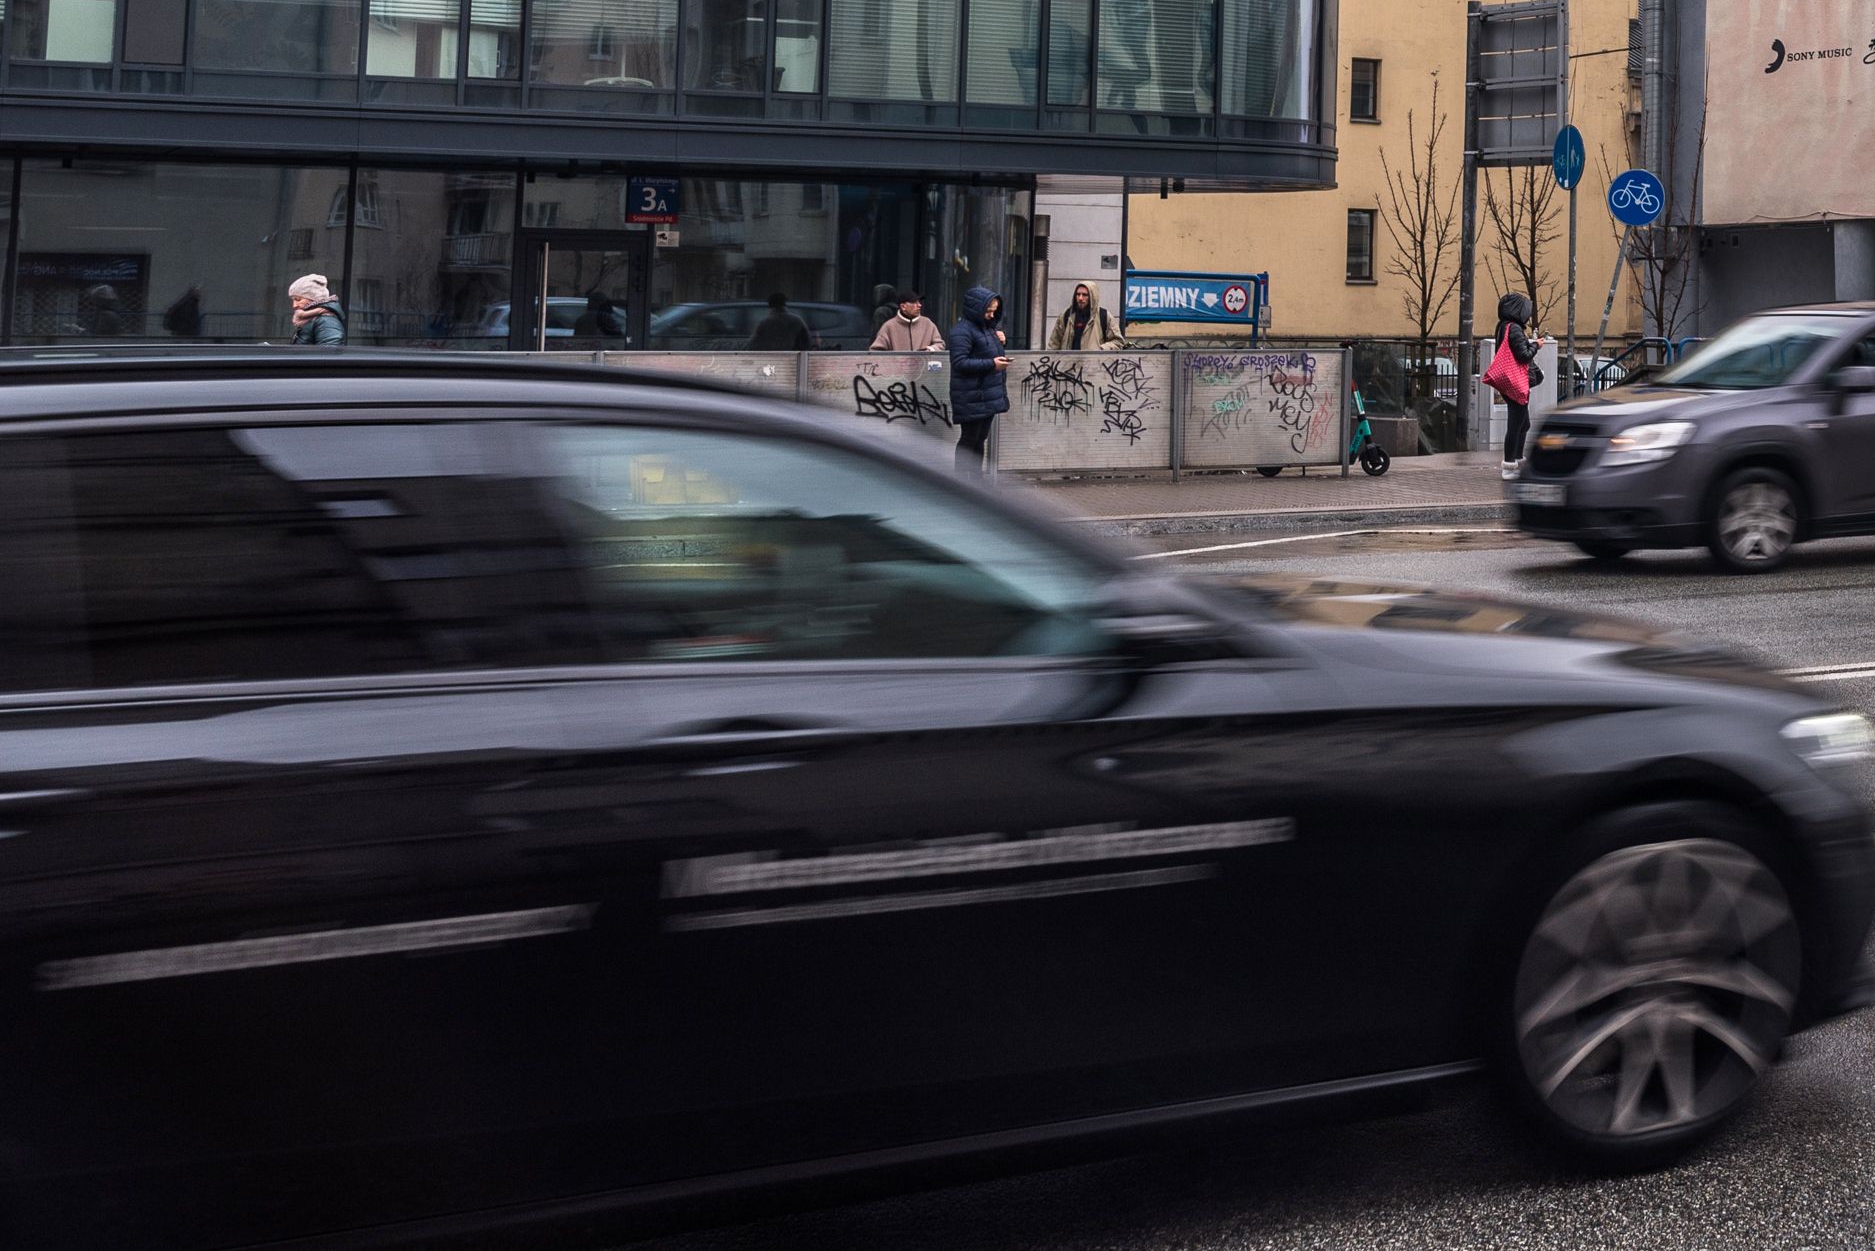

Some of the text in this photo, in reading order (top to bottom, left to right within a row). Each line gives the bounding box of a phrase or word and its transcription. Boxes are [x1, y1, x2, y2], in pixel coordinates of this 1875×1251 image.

[1787, 48, 1852, 62] SONY MUSIC
[1126, 286, 1199, 309] ZIEMNY
